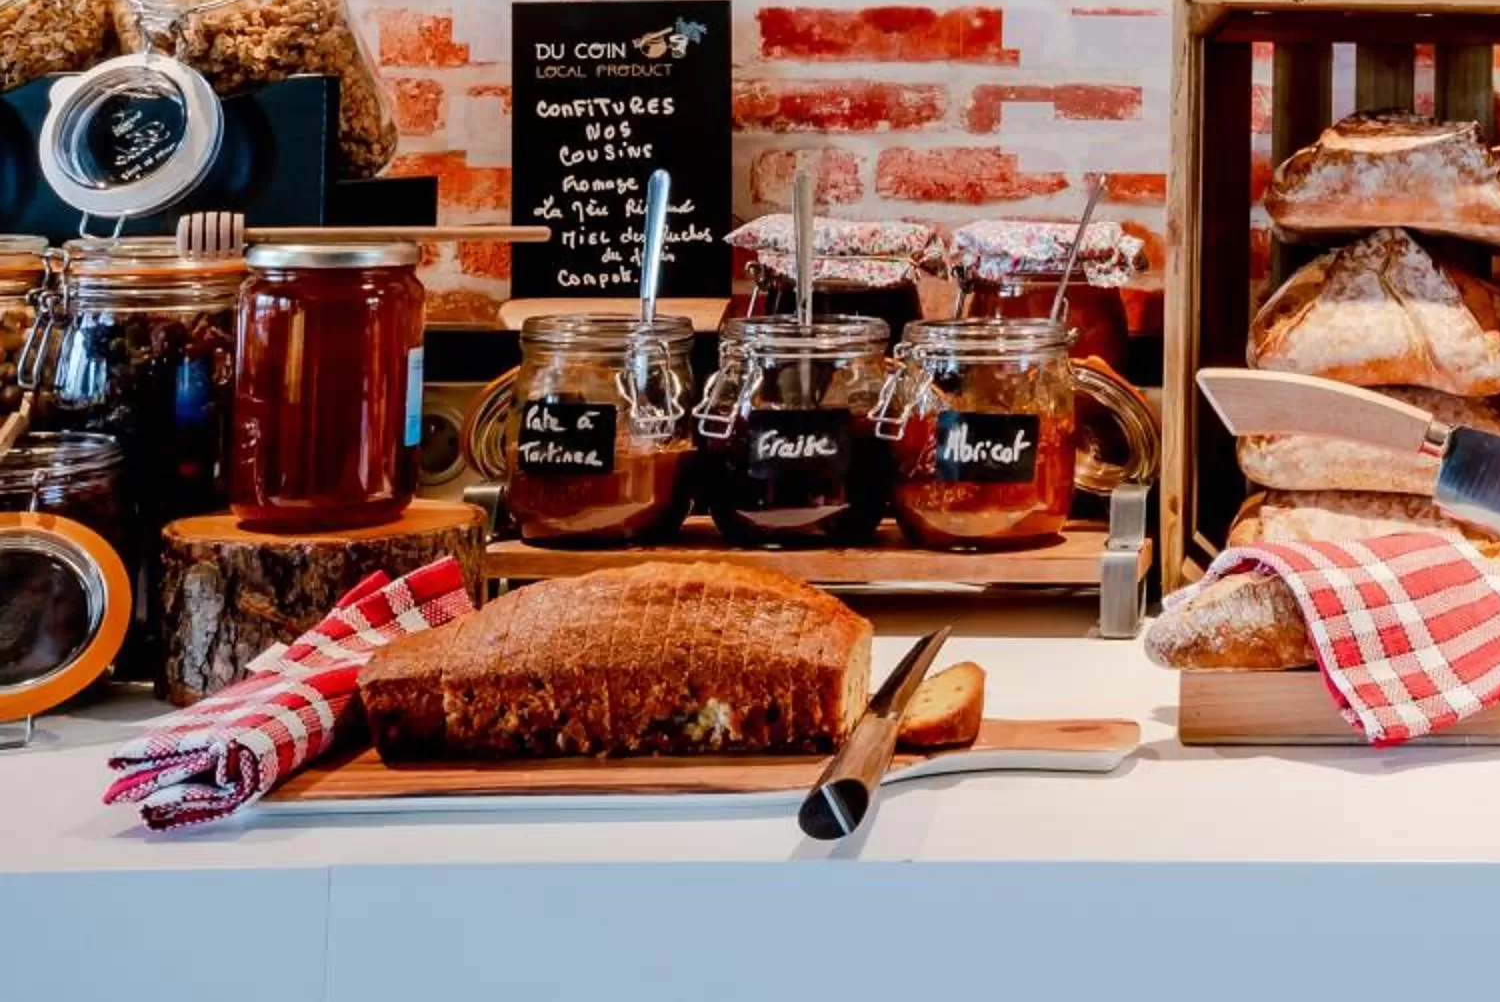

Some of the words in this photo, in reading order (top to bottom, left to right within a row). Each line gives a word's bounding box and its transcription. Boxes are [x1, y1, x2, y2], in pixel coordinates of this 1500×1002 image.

[535, 42, 565, 60] DU
[574, 42, 627, 60] COIN
[535, 65, 587, 79] LOCAL
[596, 63, 673, 77] PRODUCT
[758, 429, 838, 459] Fraise
[943, 422, 1031, 464] Abricot
